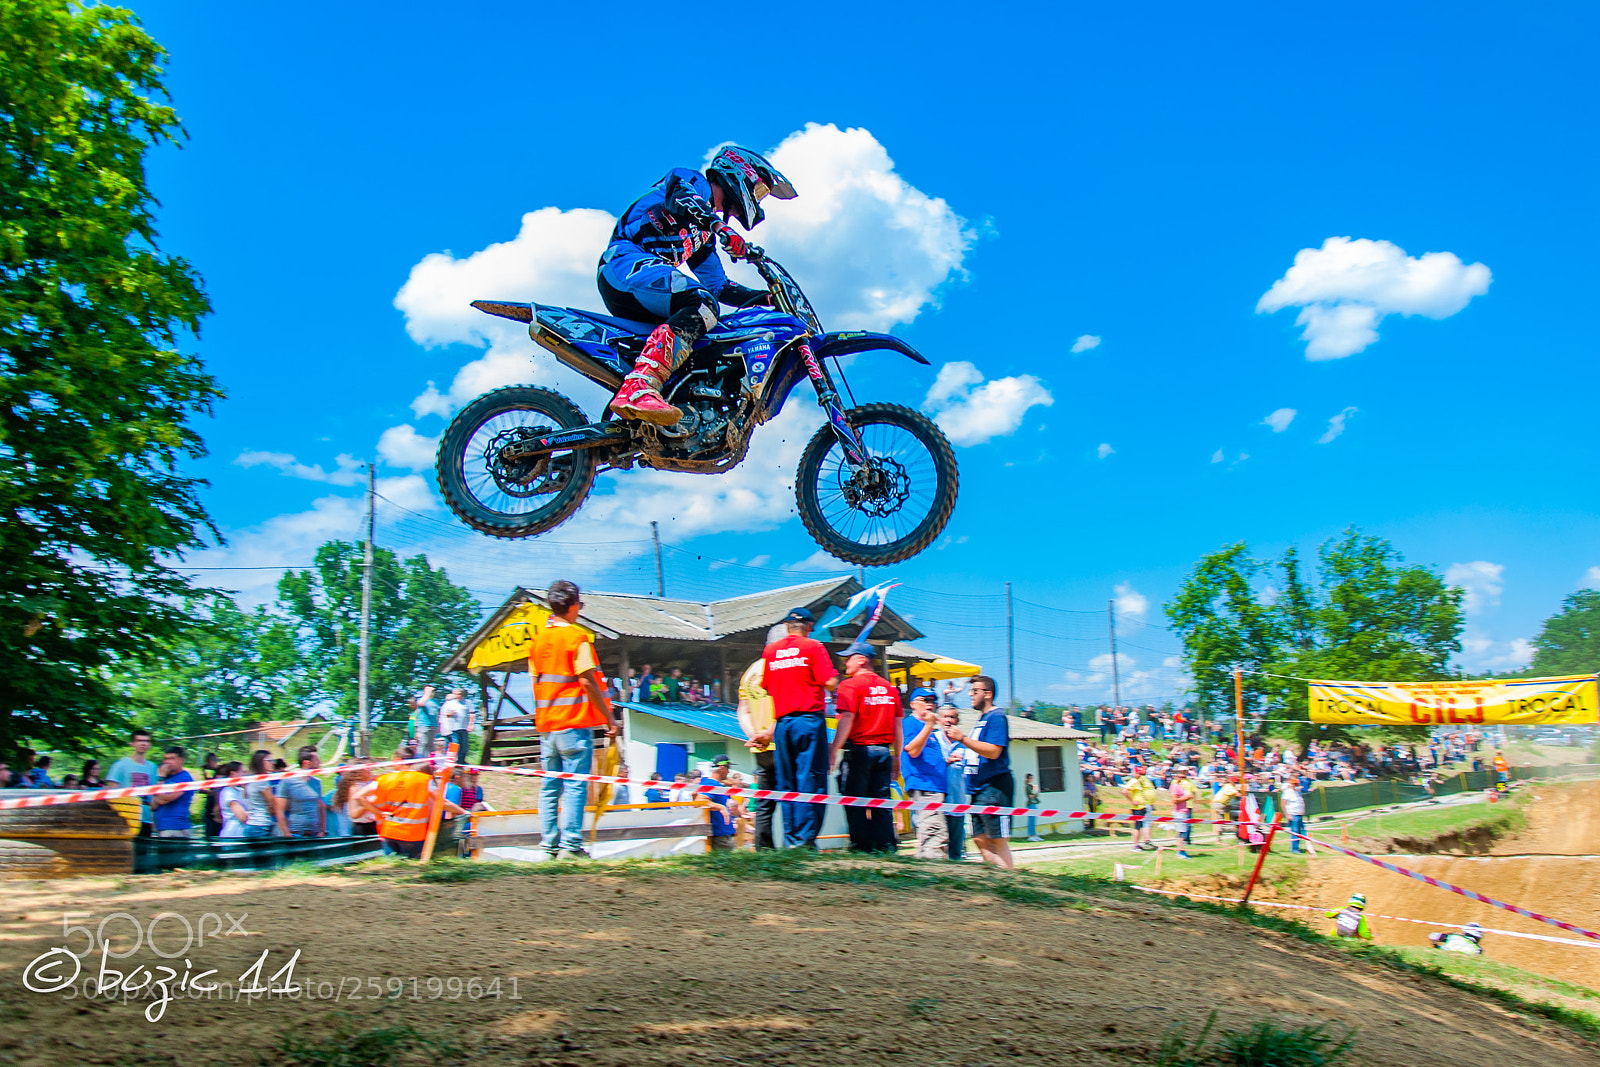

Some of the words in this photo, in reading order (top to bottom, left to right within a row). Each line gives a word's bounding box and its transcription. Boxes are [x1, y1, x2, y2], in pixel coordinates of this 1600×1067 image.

[747, 343, 771, 354] YAMAHA
[1317, 698, 1388, 715] TROCAL
[1410, 697, 1484, 724] CILJ
[1507, 696, 1588, 715] TROCAL
